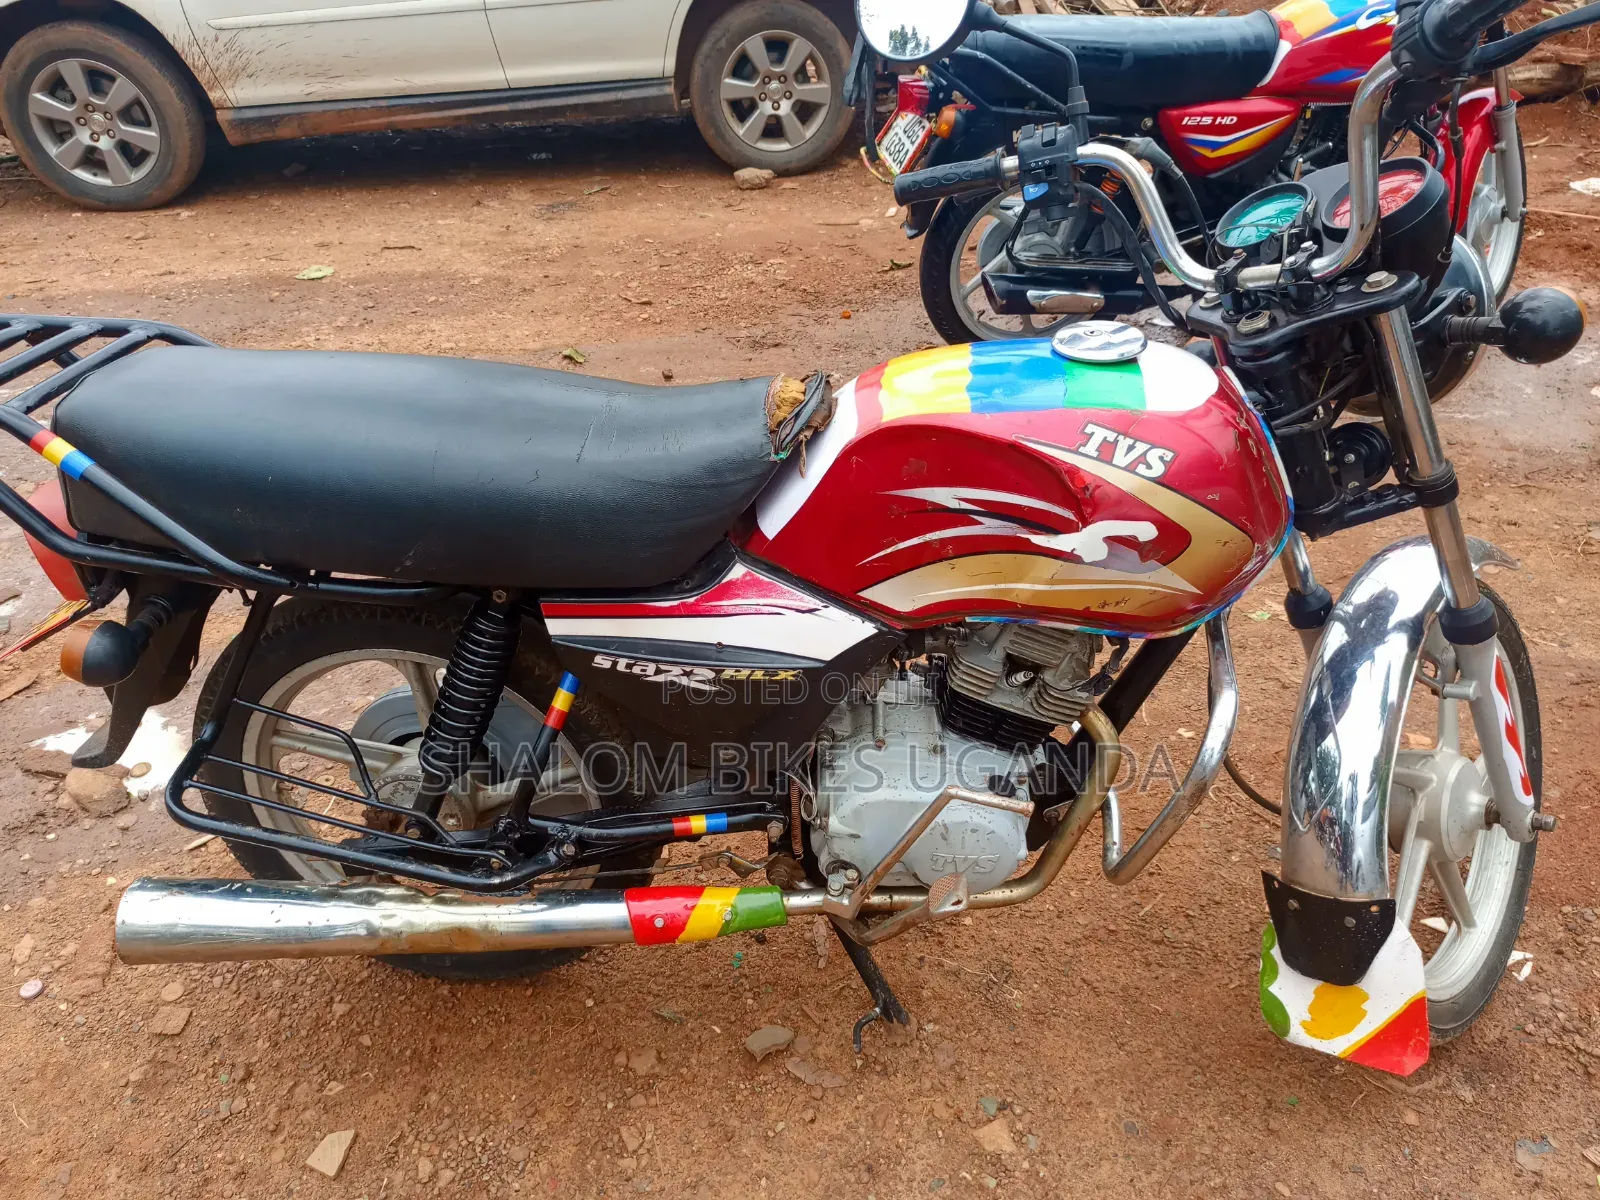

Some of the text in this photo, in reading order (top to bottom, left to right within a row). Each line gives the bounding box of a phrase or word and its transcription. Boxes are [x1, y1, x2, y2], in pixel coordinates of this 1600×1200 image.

[1181, 116, 1238, 125] 125 HD
[1077, 423, 1175, 478] TVS
[929, 851, 1000, 874] TVS
